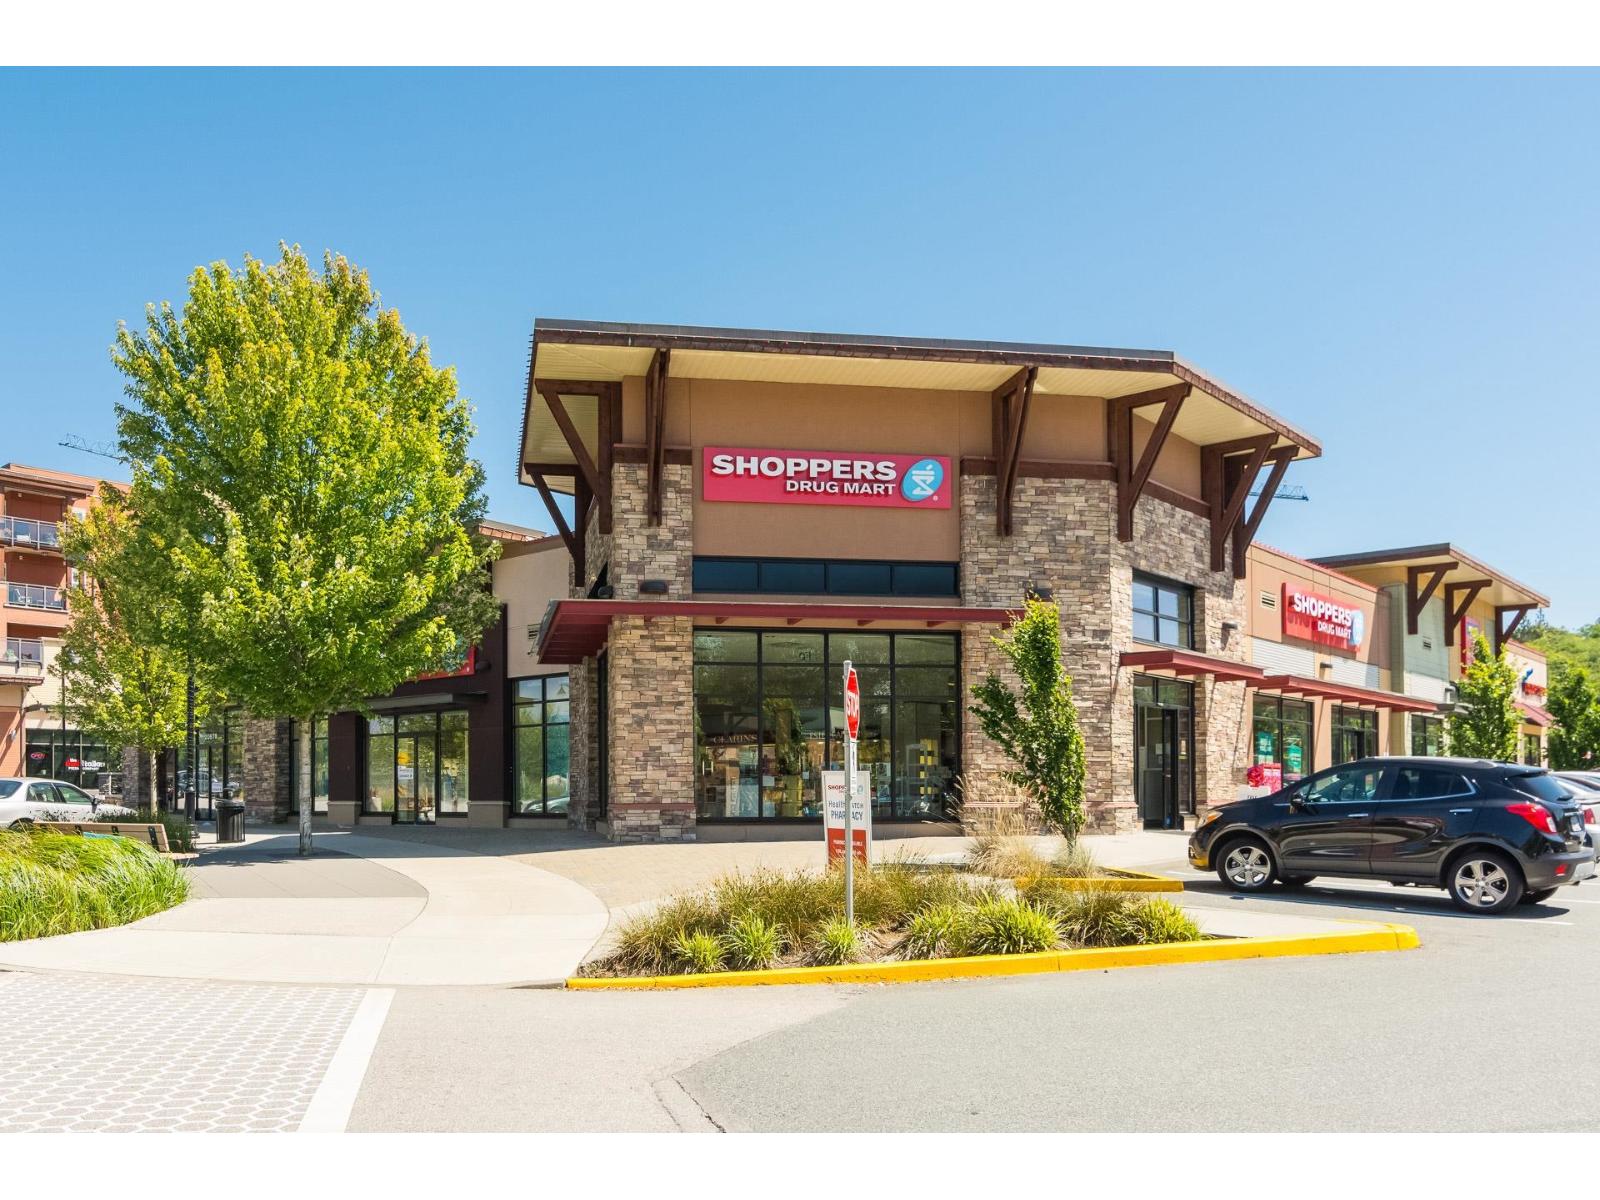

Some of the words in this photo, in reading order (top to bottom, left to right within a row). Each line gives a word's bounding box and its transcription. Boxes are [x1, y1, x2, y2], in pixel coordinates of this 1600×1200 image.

[711, 455, 897, 480] SHOPPERS
[786, 480, 839, 494] DRUG
[843, 482, 897, 495] MART
[1293, 592, 1352, 627] SHOPPERS
[1317, 621, 1335, 635] DRUG
[1335, 626, 1352, 640] MART
[847, 690, 859, 718] STOP
[830, 810, 864, 821] PHARACY
